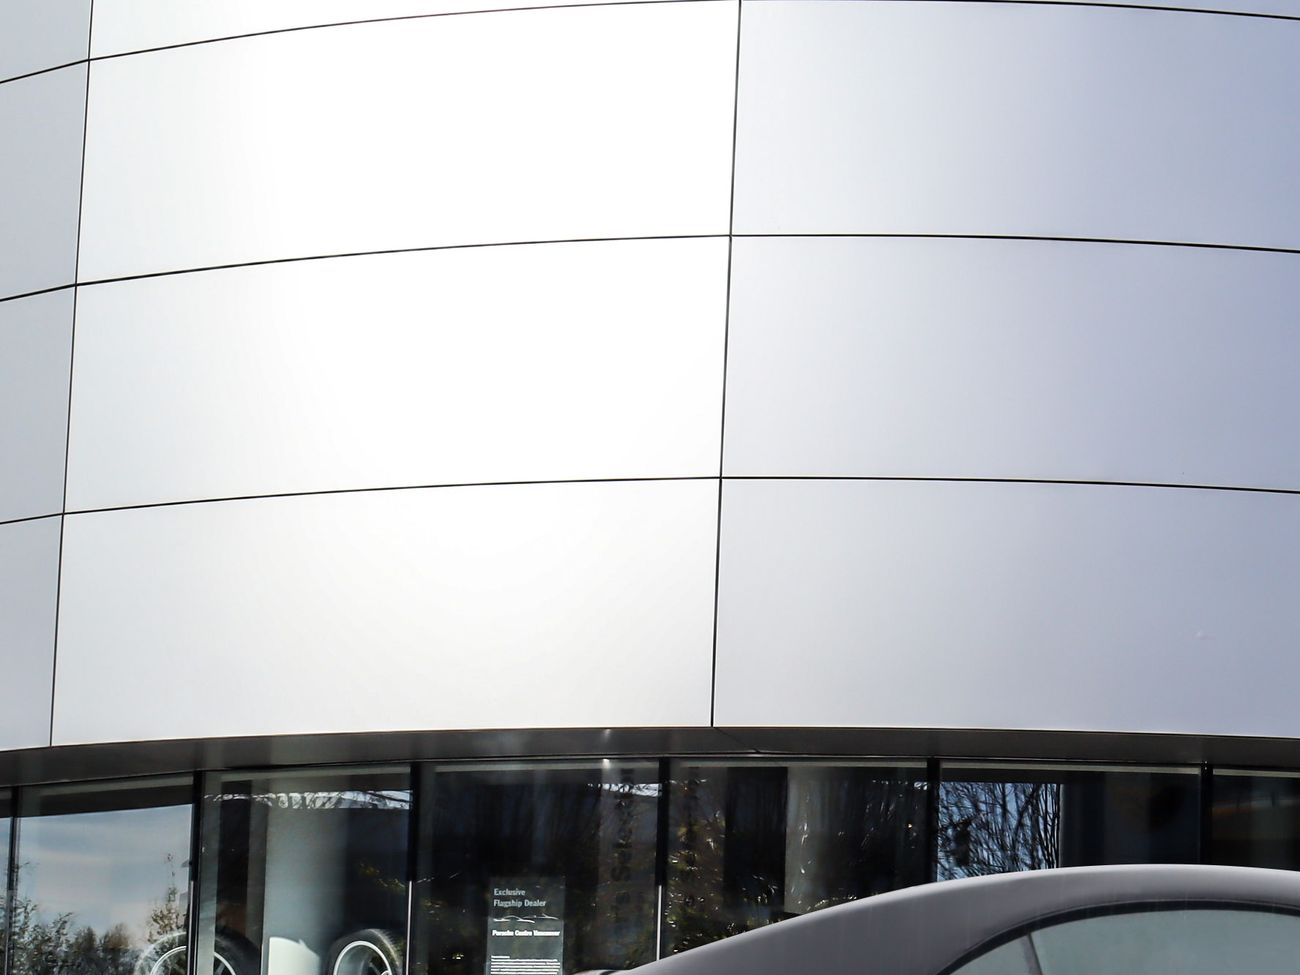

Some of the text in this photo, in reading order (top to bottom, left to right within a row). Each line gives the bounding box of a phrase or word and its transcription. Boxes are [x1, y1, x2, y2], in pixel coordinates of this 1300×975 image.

[494, 888, 526, 896] Exclusive
[493, 899, 547, 908] Flagship Dealer
